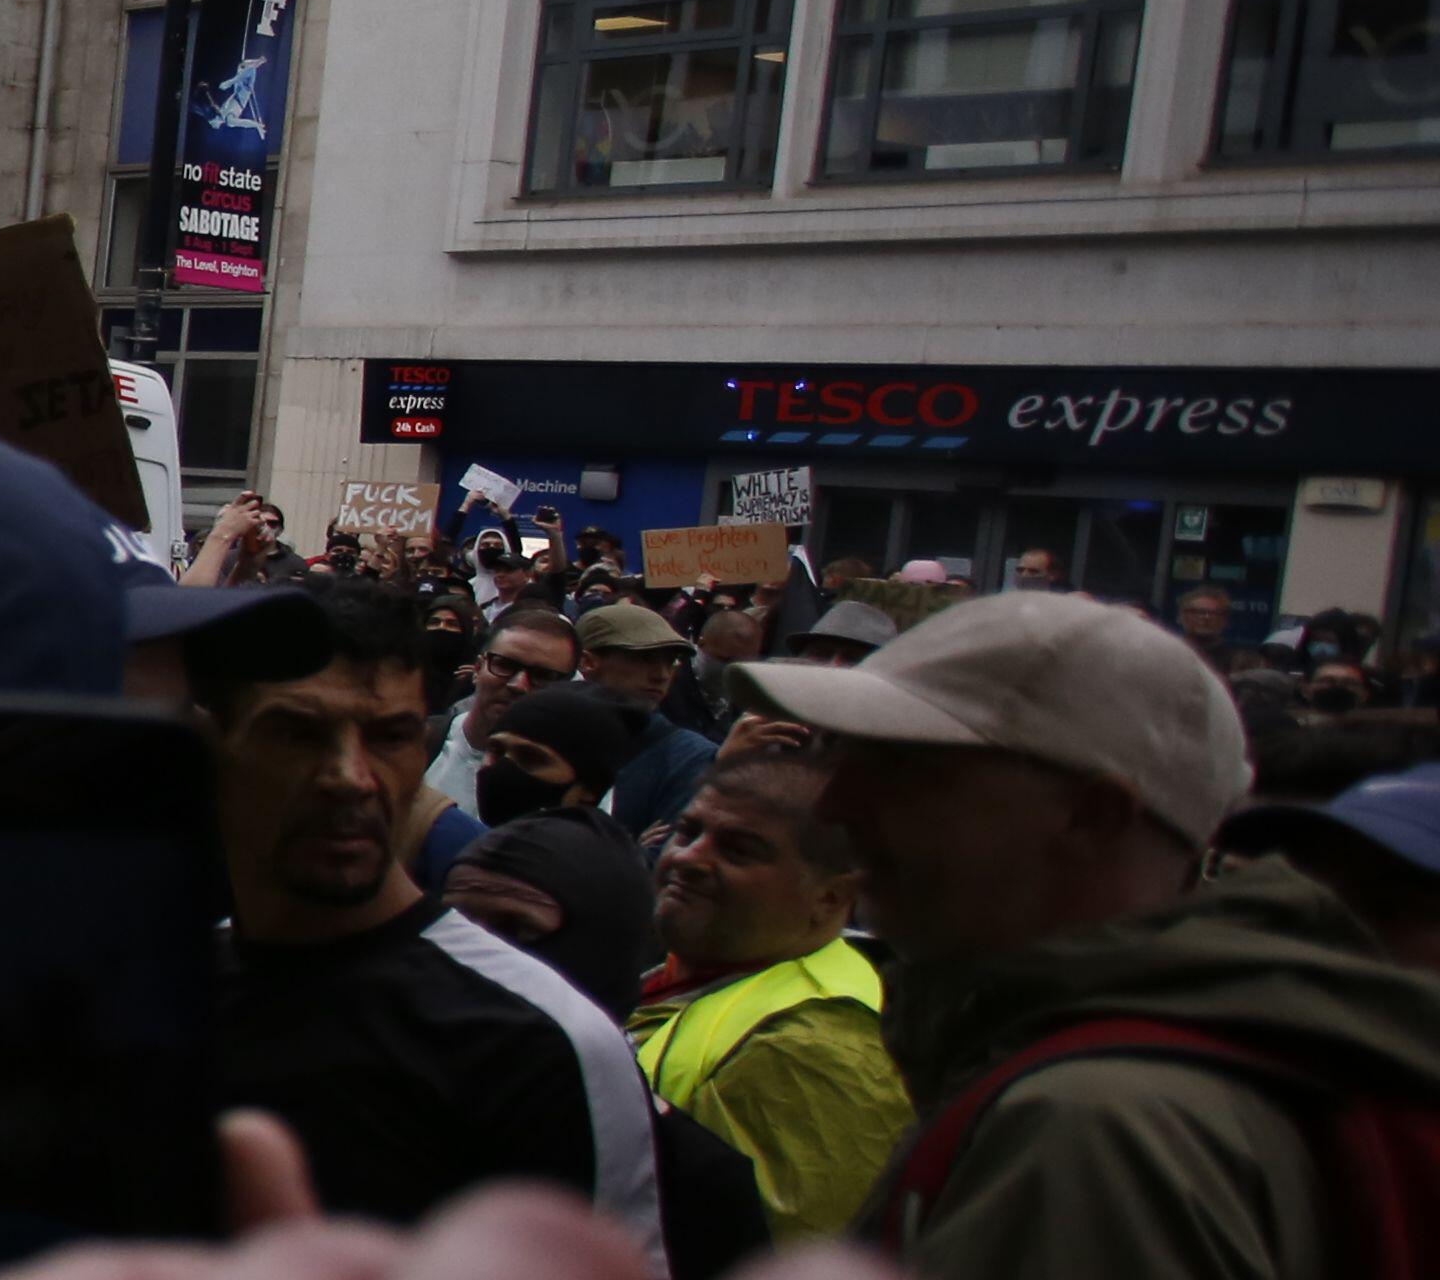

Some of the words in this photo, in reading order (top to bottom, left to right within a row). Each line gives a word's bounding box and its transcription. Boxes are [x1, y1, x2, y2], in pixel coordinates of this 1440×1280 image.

[202, 190, 253, 213] circus
[179, 206, 260, 242] SABOTAGE
[176, 255, 193, 269] The
[194, 258, 219, 274] Level,
[221, 261, 259, 278] Brighton
[391, 366, 452, 384] TESCO
[388, 395, 445, 414] express
[735, 379, 979, 429] TESCO
[1008, 387, 1295, 447] express
[395, 422, 412, 433] 24h
[415, 422, 436, 434] Cash
[345, 483, 422, 507] FUCK
[733, 468, 799, 499] WHITE
[736, 490, 797, 517] SUPREMACY
[799, 489, 809, 504] IS
[336, 504, 434, 533] FASCISM
[645, 531, 680, 549] Love
[687, 525, 759, 554] Brighton
